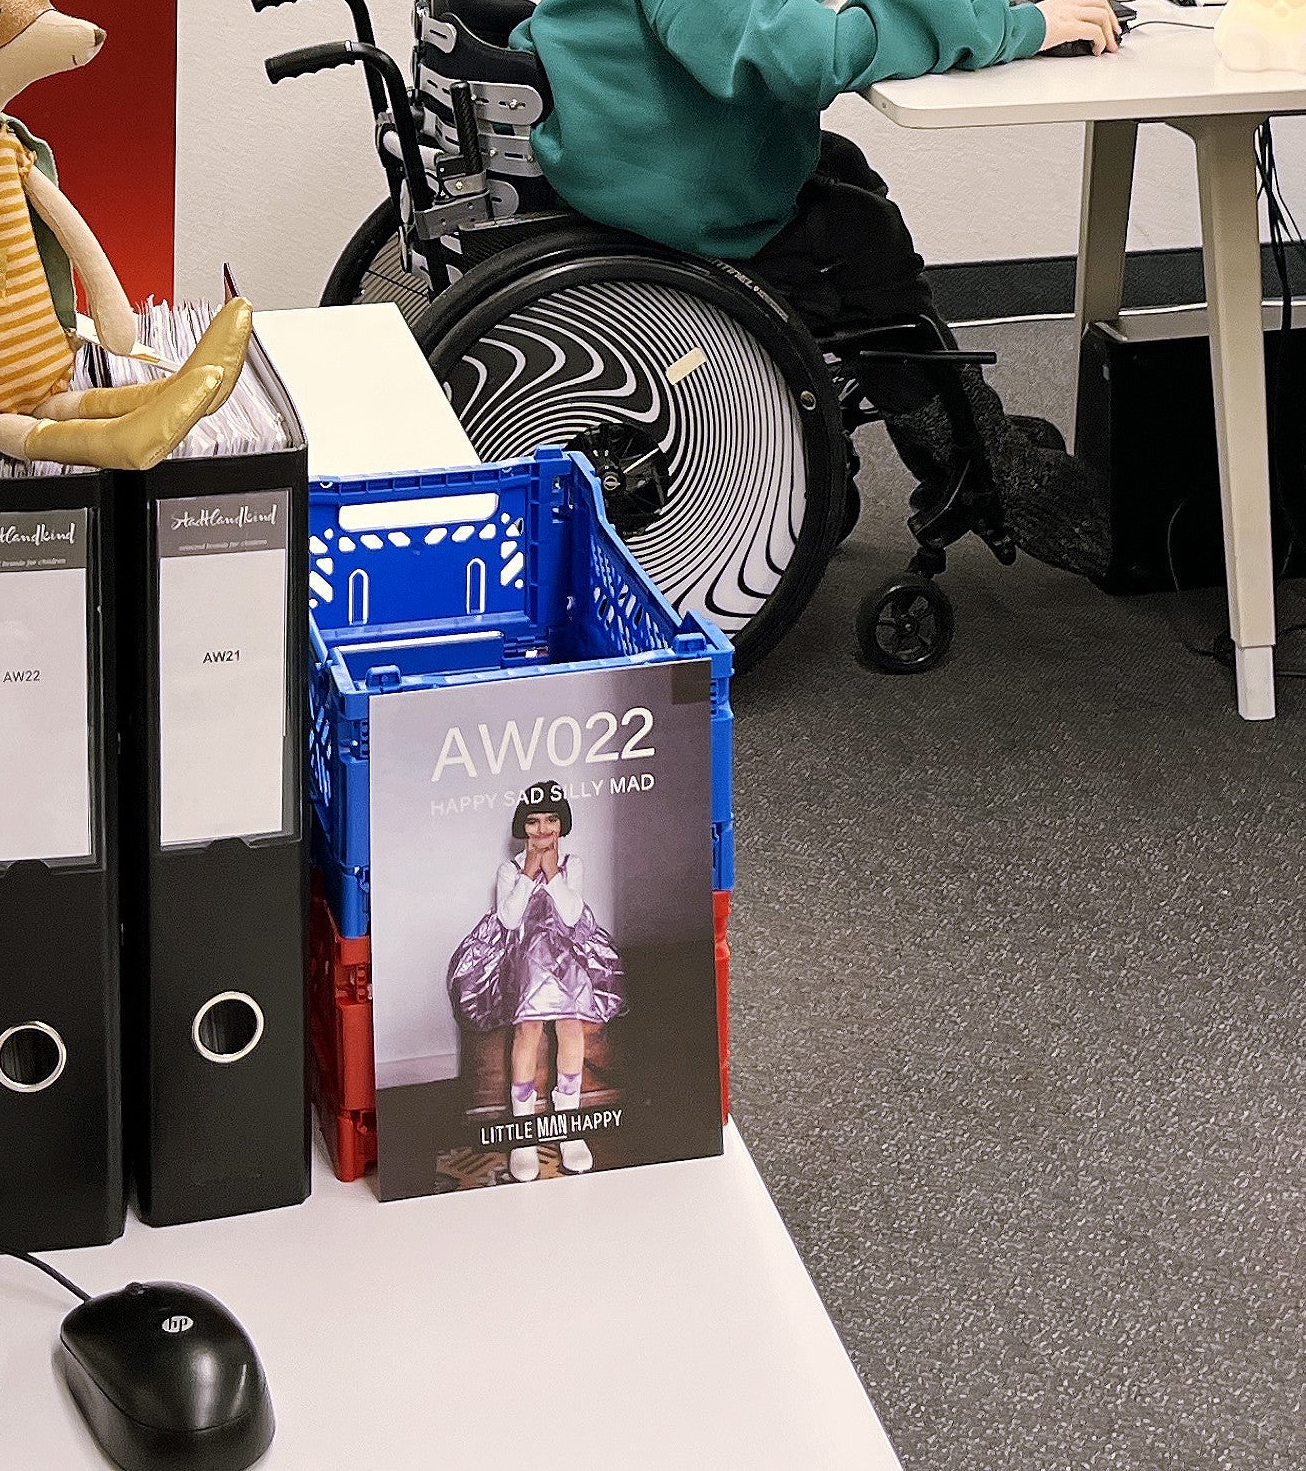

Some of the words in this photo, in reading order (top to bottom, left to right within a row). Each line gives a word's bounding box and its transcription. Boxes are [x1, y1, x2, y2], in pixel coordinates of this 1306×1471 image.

[171, 504, 277, 530] Stadtlandkind
[202, 650, 240, 663] AW21
[3, 670, 41, 682] AW22
[430, 706, 655, 782] AW022
[430, 793, 501, 816] HAPPY
[503, 787, 544, 806] SAD
[550, 780, 603, 802] SILLY
[610, 773, 655, 795] MAD
[481, 1121, 533, 1145] LITTLE
[536, 1114, 568, 1139] MAN
[571, 1109, 623, 1133] HAPPY
